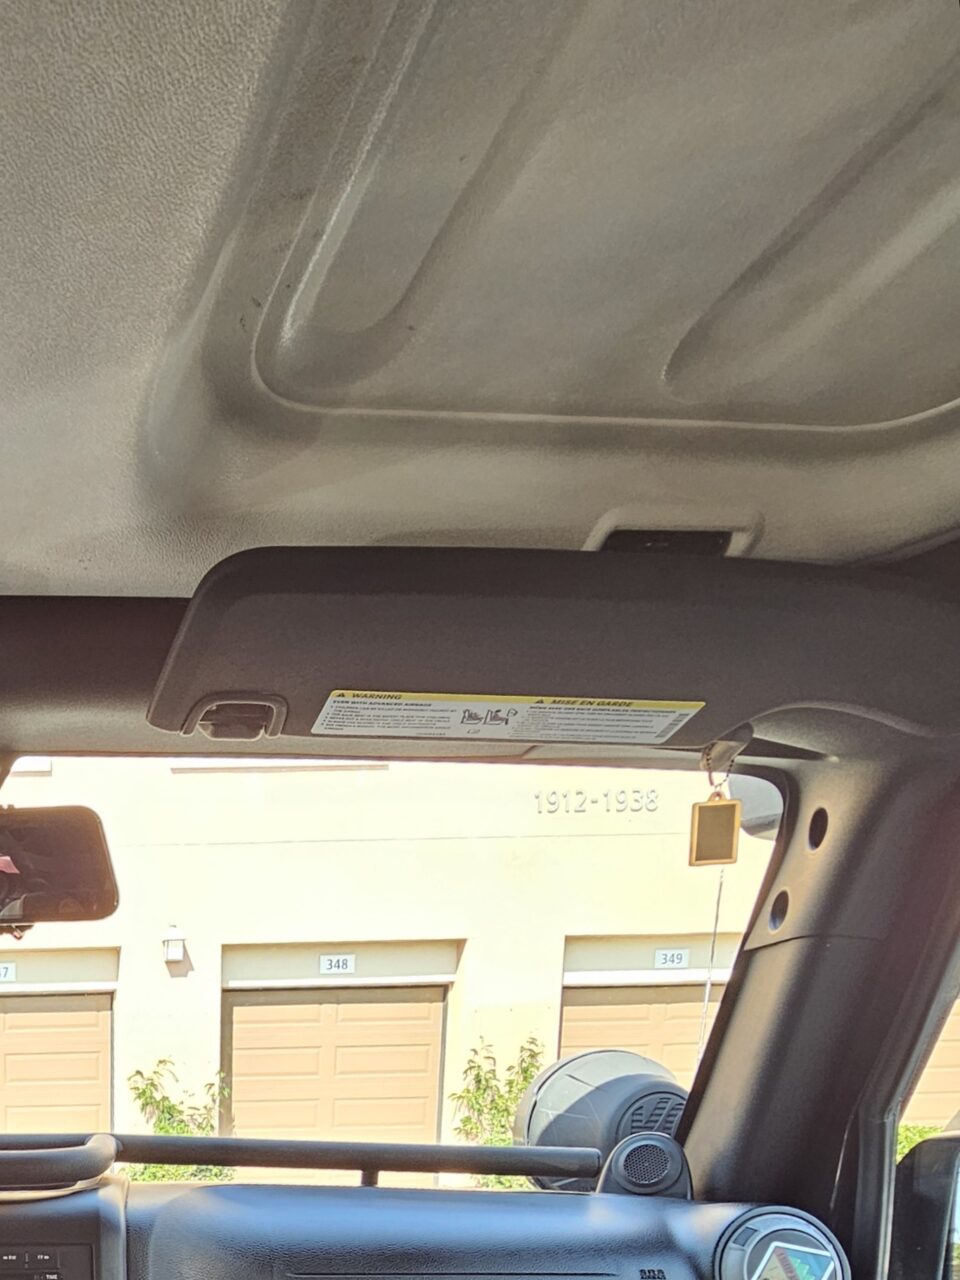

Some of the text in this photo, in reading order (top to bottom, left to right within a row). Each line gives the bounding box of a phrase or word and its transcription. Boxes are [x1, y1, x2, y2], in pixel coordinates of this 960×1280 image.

[352, 692, 403, 700] WARNING
[534, 789, 659, 814] 1912-1938
[326, 958, 348, 970] 348
[661, 953, 683, 965] 349
